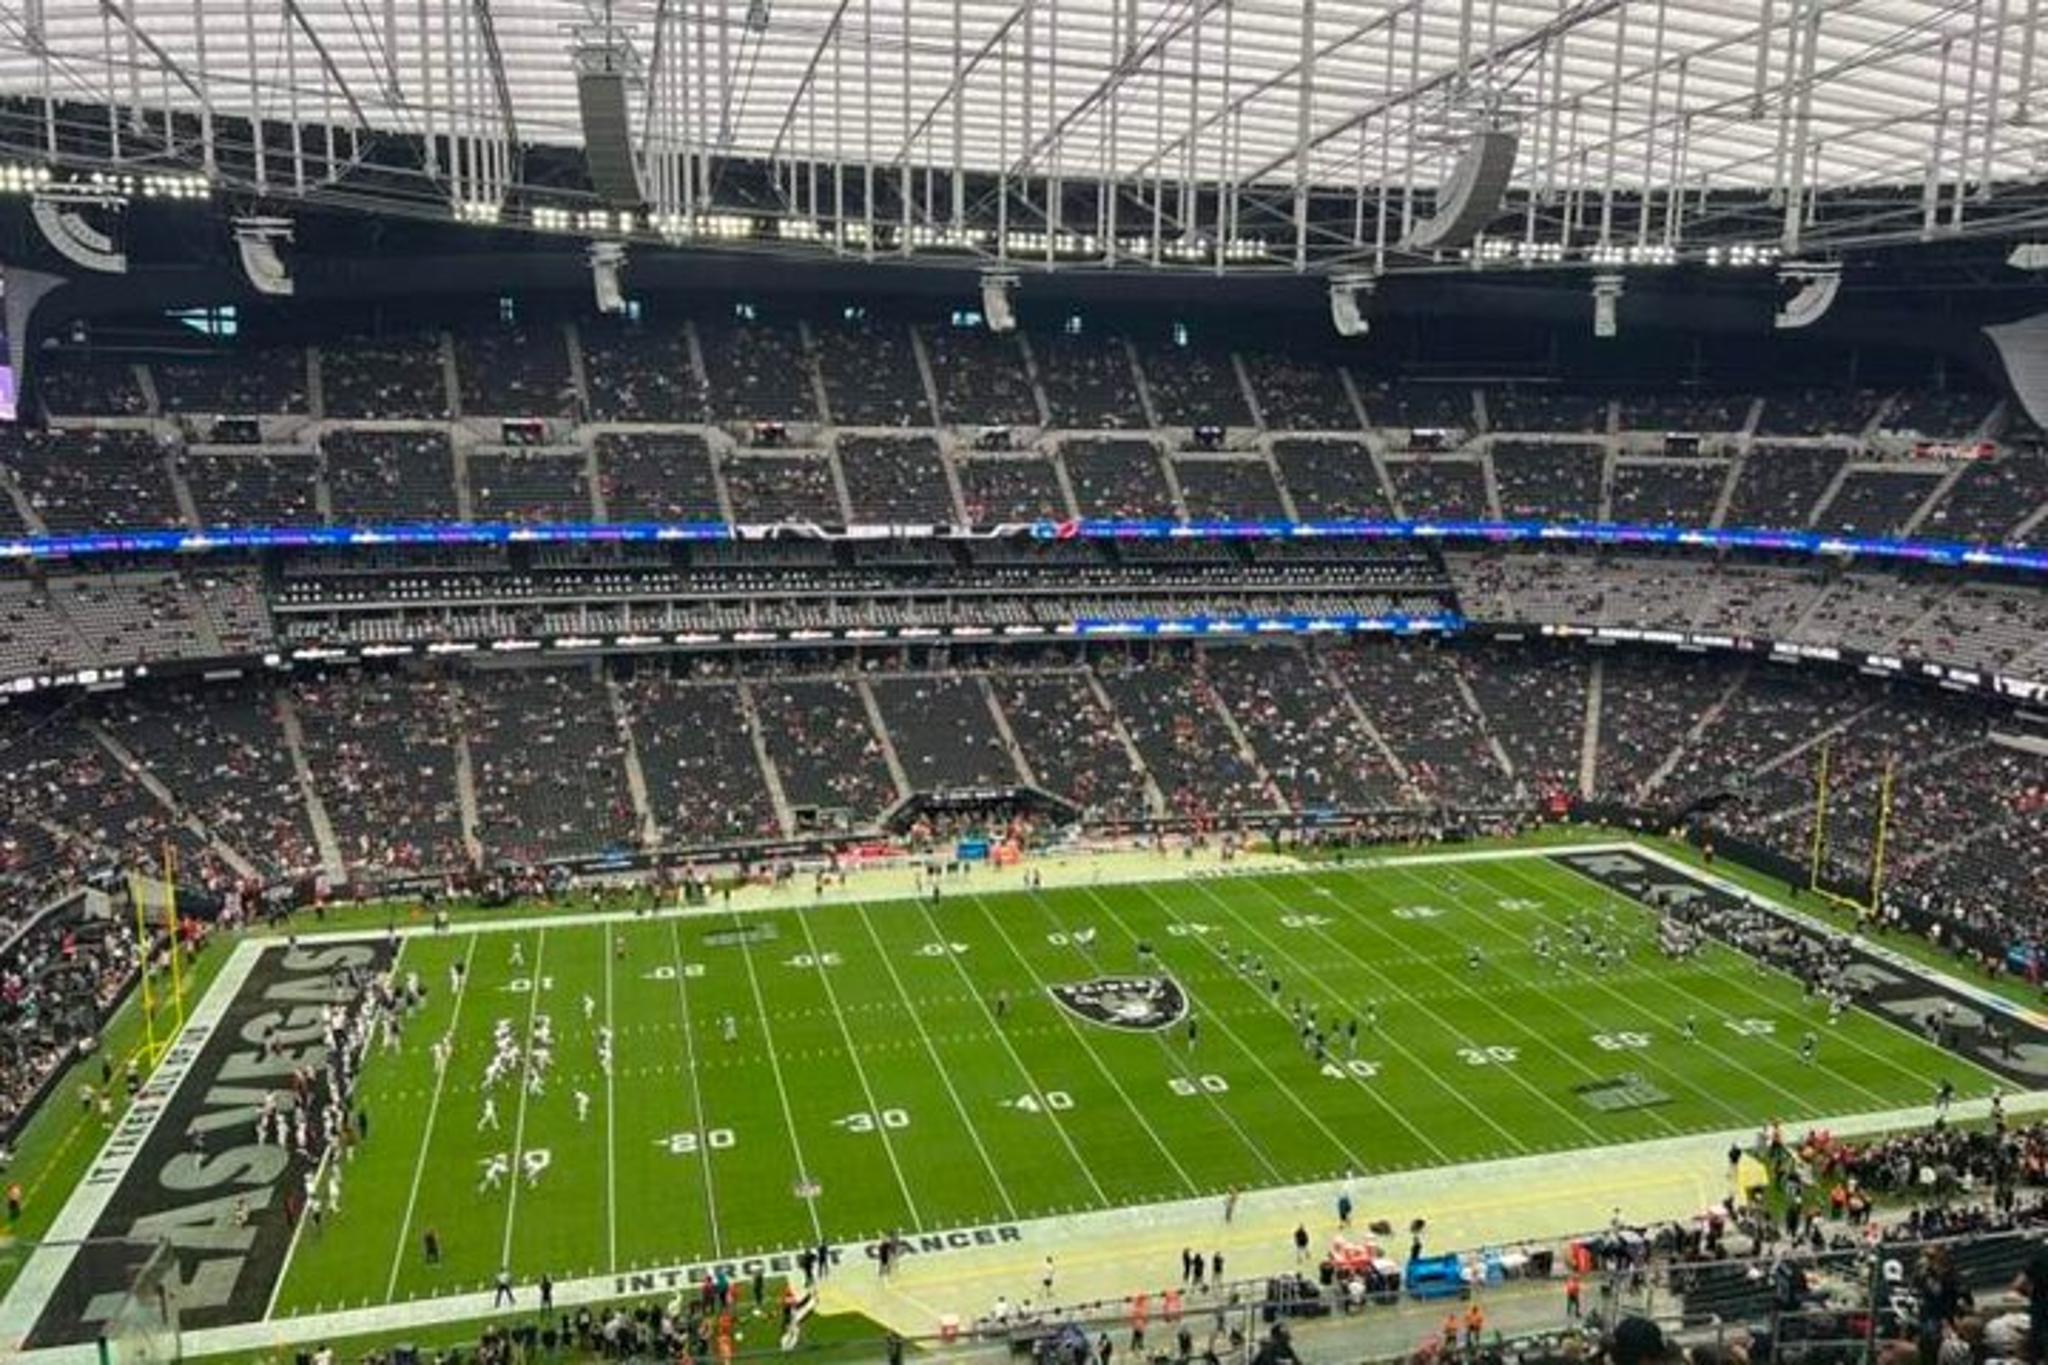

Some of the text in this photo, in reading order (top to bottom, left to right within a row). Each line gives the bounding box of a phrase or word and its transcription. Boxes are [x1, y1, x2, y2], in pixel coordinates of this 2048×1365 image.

[1015, 1090, 1074, 1112] 40
[847, 1108, 911, 1132] 30
[82, 944, 376, 1322] LAS VEGAS
[669, 1128, 735, 1153] 20
[615, 1248, 843, 1294] INTERCET
